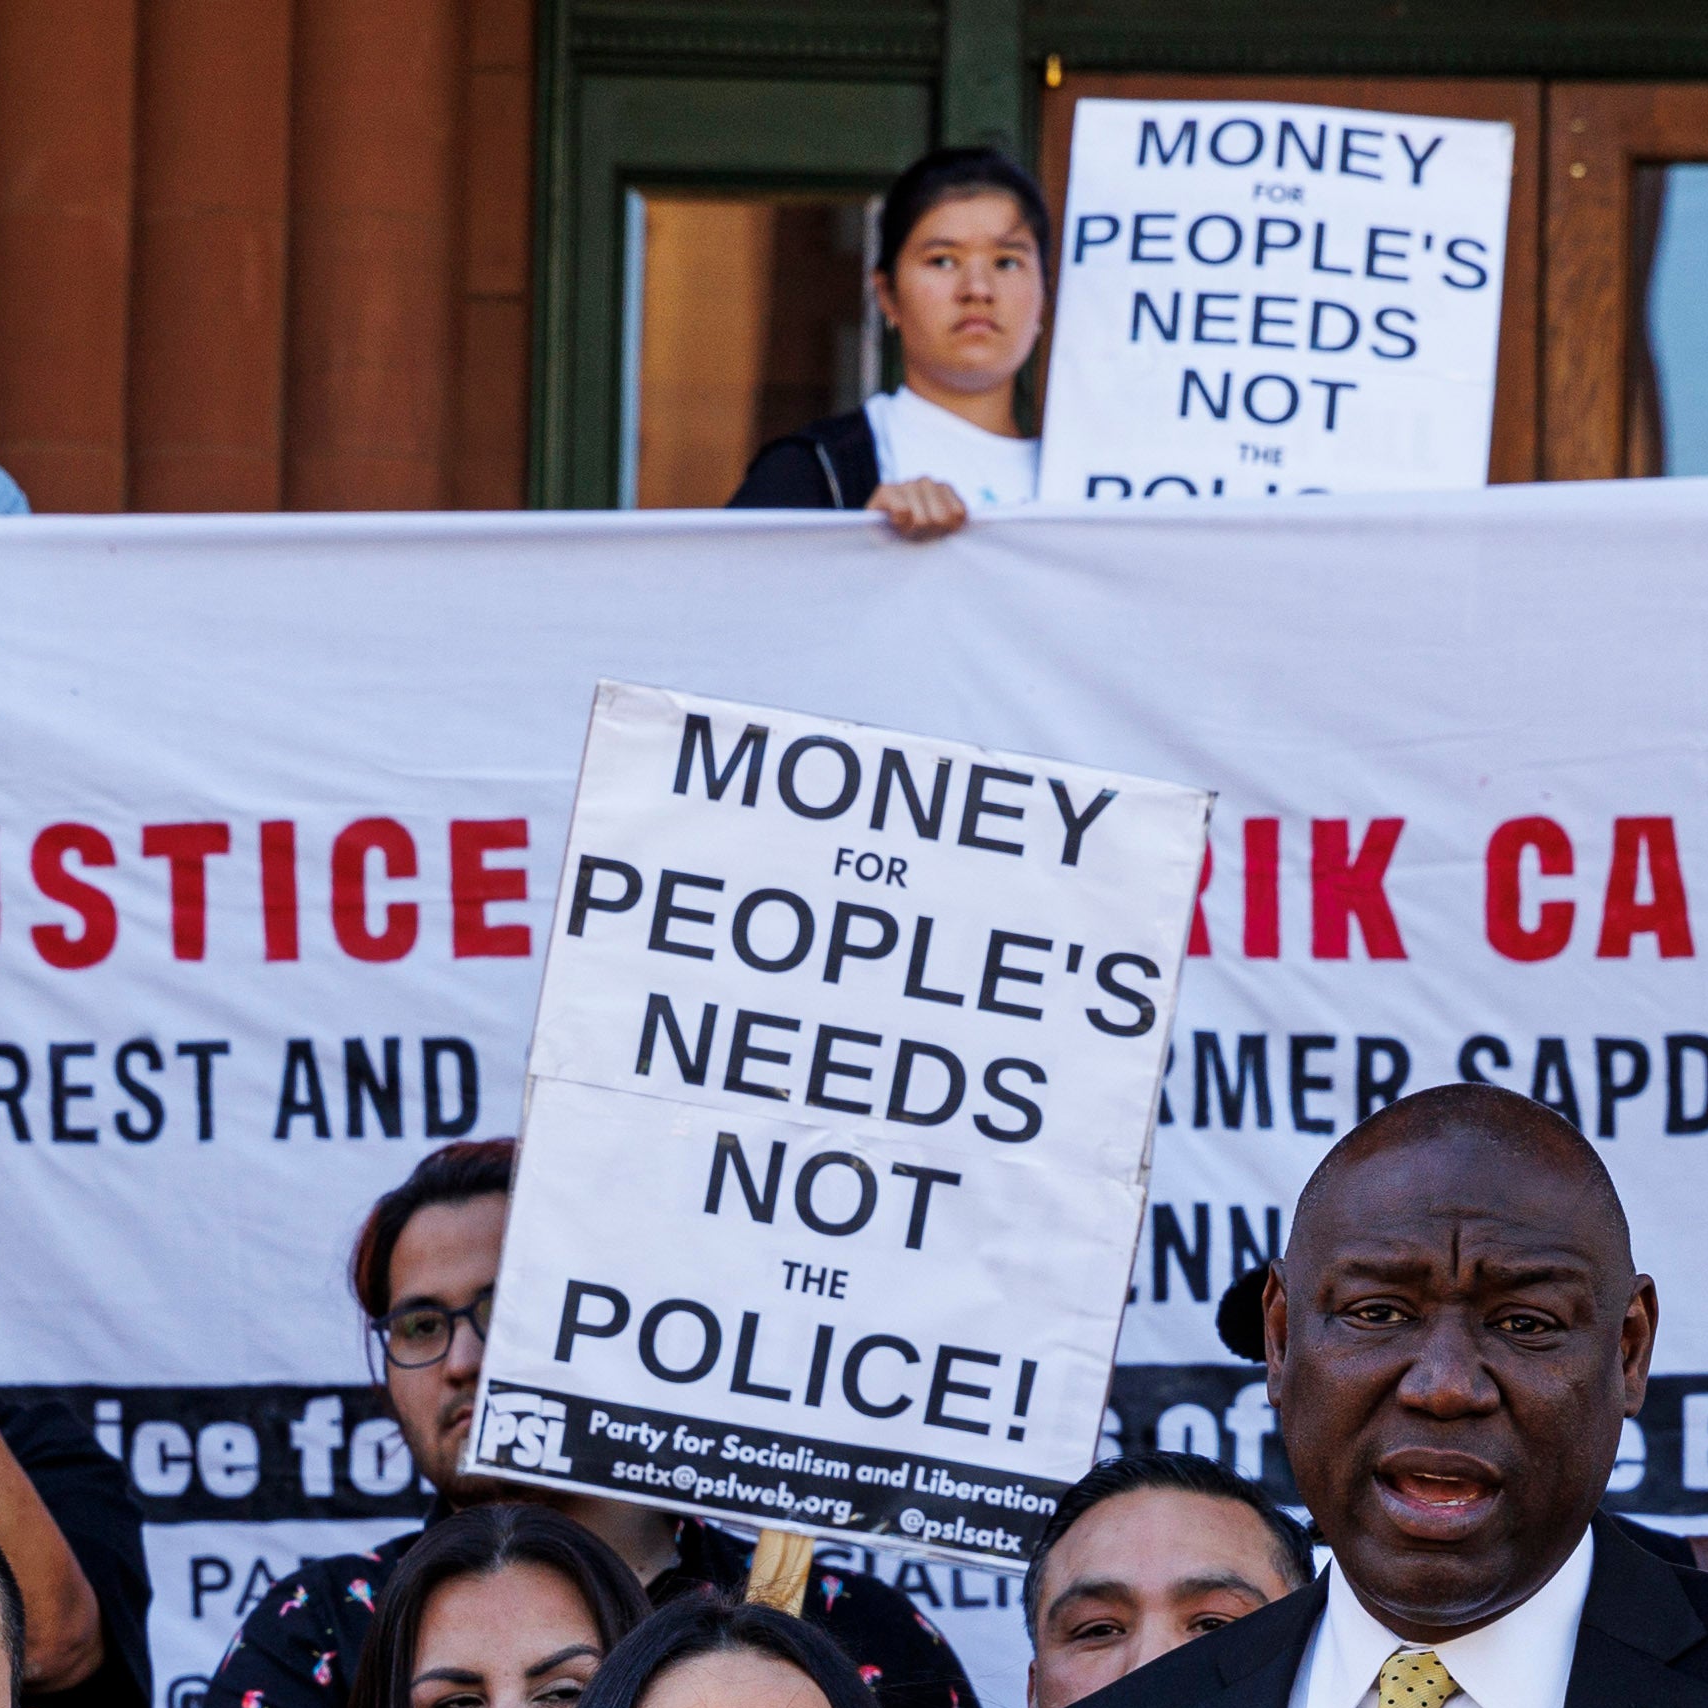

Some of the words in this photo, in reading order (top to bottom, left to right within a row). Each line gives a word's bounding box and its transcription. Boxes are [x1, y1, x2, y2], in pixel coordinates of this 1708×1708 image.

[1136, 119, 1444, 187] MONEY
[1253, 183, 1305, 204] FOR
[1073, 213, 1489, 292] PEOPLE'S
[1129, 291, 1419, 361] NEEDS
[1179, 370, 1359, 432] NOT
[1238, 443, 1285, 467] THE
[672, 713, 1119, 867] MONEY
[833, 846, 910, 890] FOR
[1187, 817, 1409, 959] IK
[566, 853, 1161, 1038] PEOPLE'S
[272, 1035, 481, 1141] AND
[635, 993, 1049, 1144] NEEDS
[703, 1131, 962, 1250] NOT
[782, 1259, 850, 1301] THE
[553, 1279, 1039, 1443] POLICE!
[289, 1395, 438, 1497] fo
[481, 1411, 573, 1474] PSL
[588, 1410, 669, 1453] Party
[672, 1424, 716, 1457] for
[720, 1433, 851, 1484] Socialism
[855, 1455, 910, 1488] and
[914, 1466, 1057, 1518] Liberation
[611, 1456, 854, 1525] satx@pslweb.org
[899, 1507, 1023, 1554] @pslsatx
